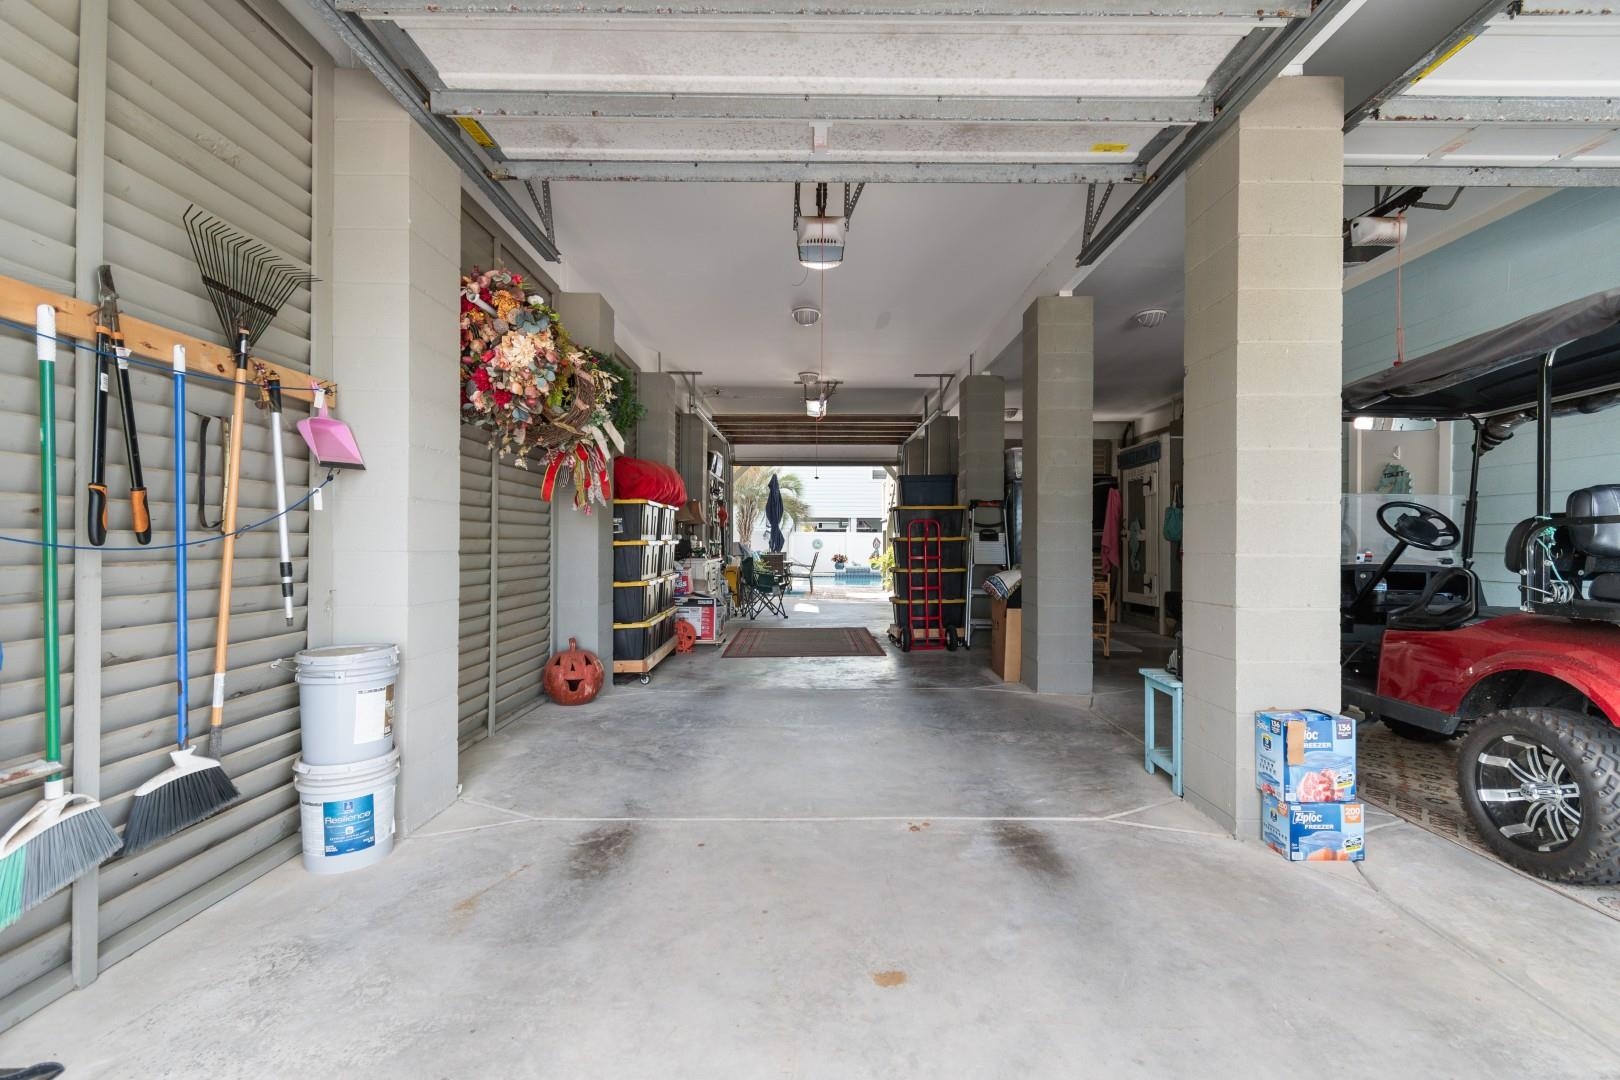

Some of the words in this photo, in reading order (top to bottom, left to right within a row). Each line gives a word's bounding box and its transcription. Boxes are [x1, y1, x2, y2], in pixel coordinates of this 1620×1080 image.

[1338, 724, 1352, 732] 136
[1345, 807, 1361, 815] 200
[324, 811, 371, 824] Resilience
[1295, 812, 1323, 824] Ziploc
